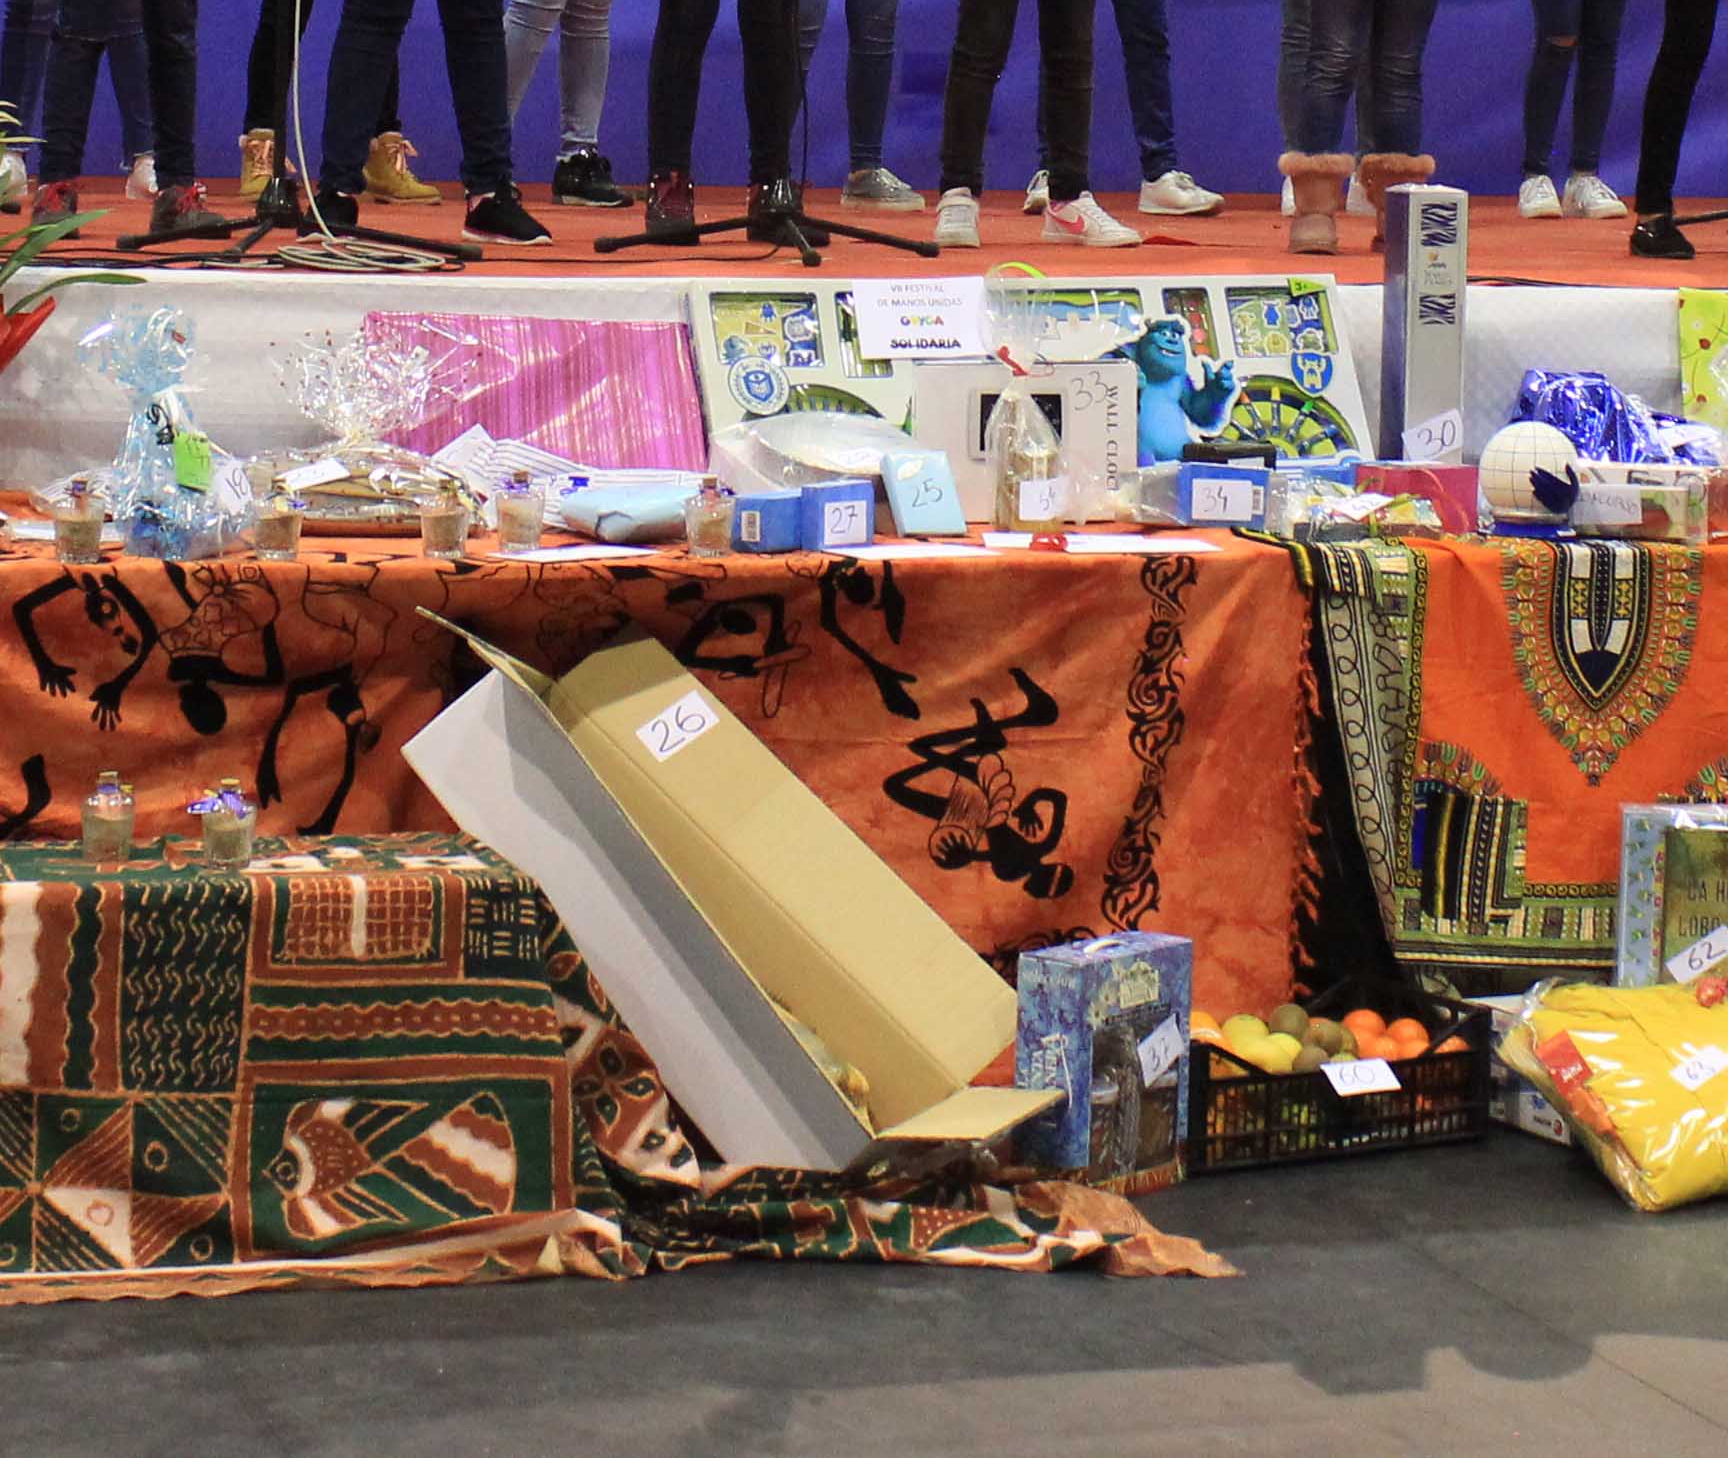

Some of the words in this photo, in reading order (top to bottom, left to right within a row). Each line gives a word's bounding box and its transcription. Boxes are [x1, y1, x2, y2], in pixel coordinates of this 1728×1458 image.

[890, 338, 962, 349] SOLIDARIA
[1071, 370, 1109, 411] 33
[1106, 385, 1119, 433] WALL
[1417, 418, 1456, 457] 30
[911, 478, 944, 509] 25
[1203, 486, 1229, 515] 34
[830, 504, 858, 535] 27
[648, 703, 707, 755] 26
[1687, 941, 1728, 971] 62
